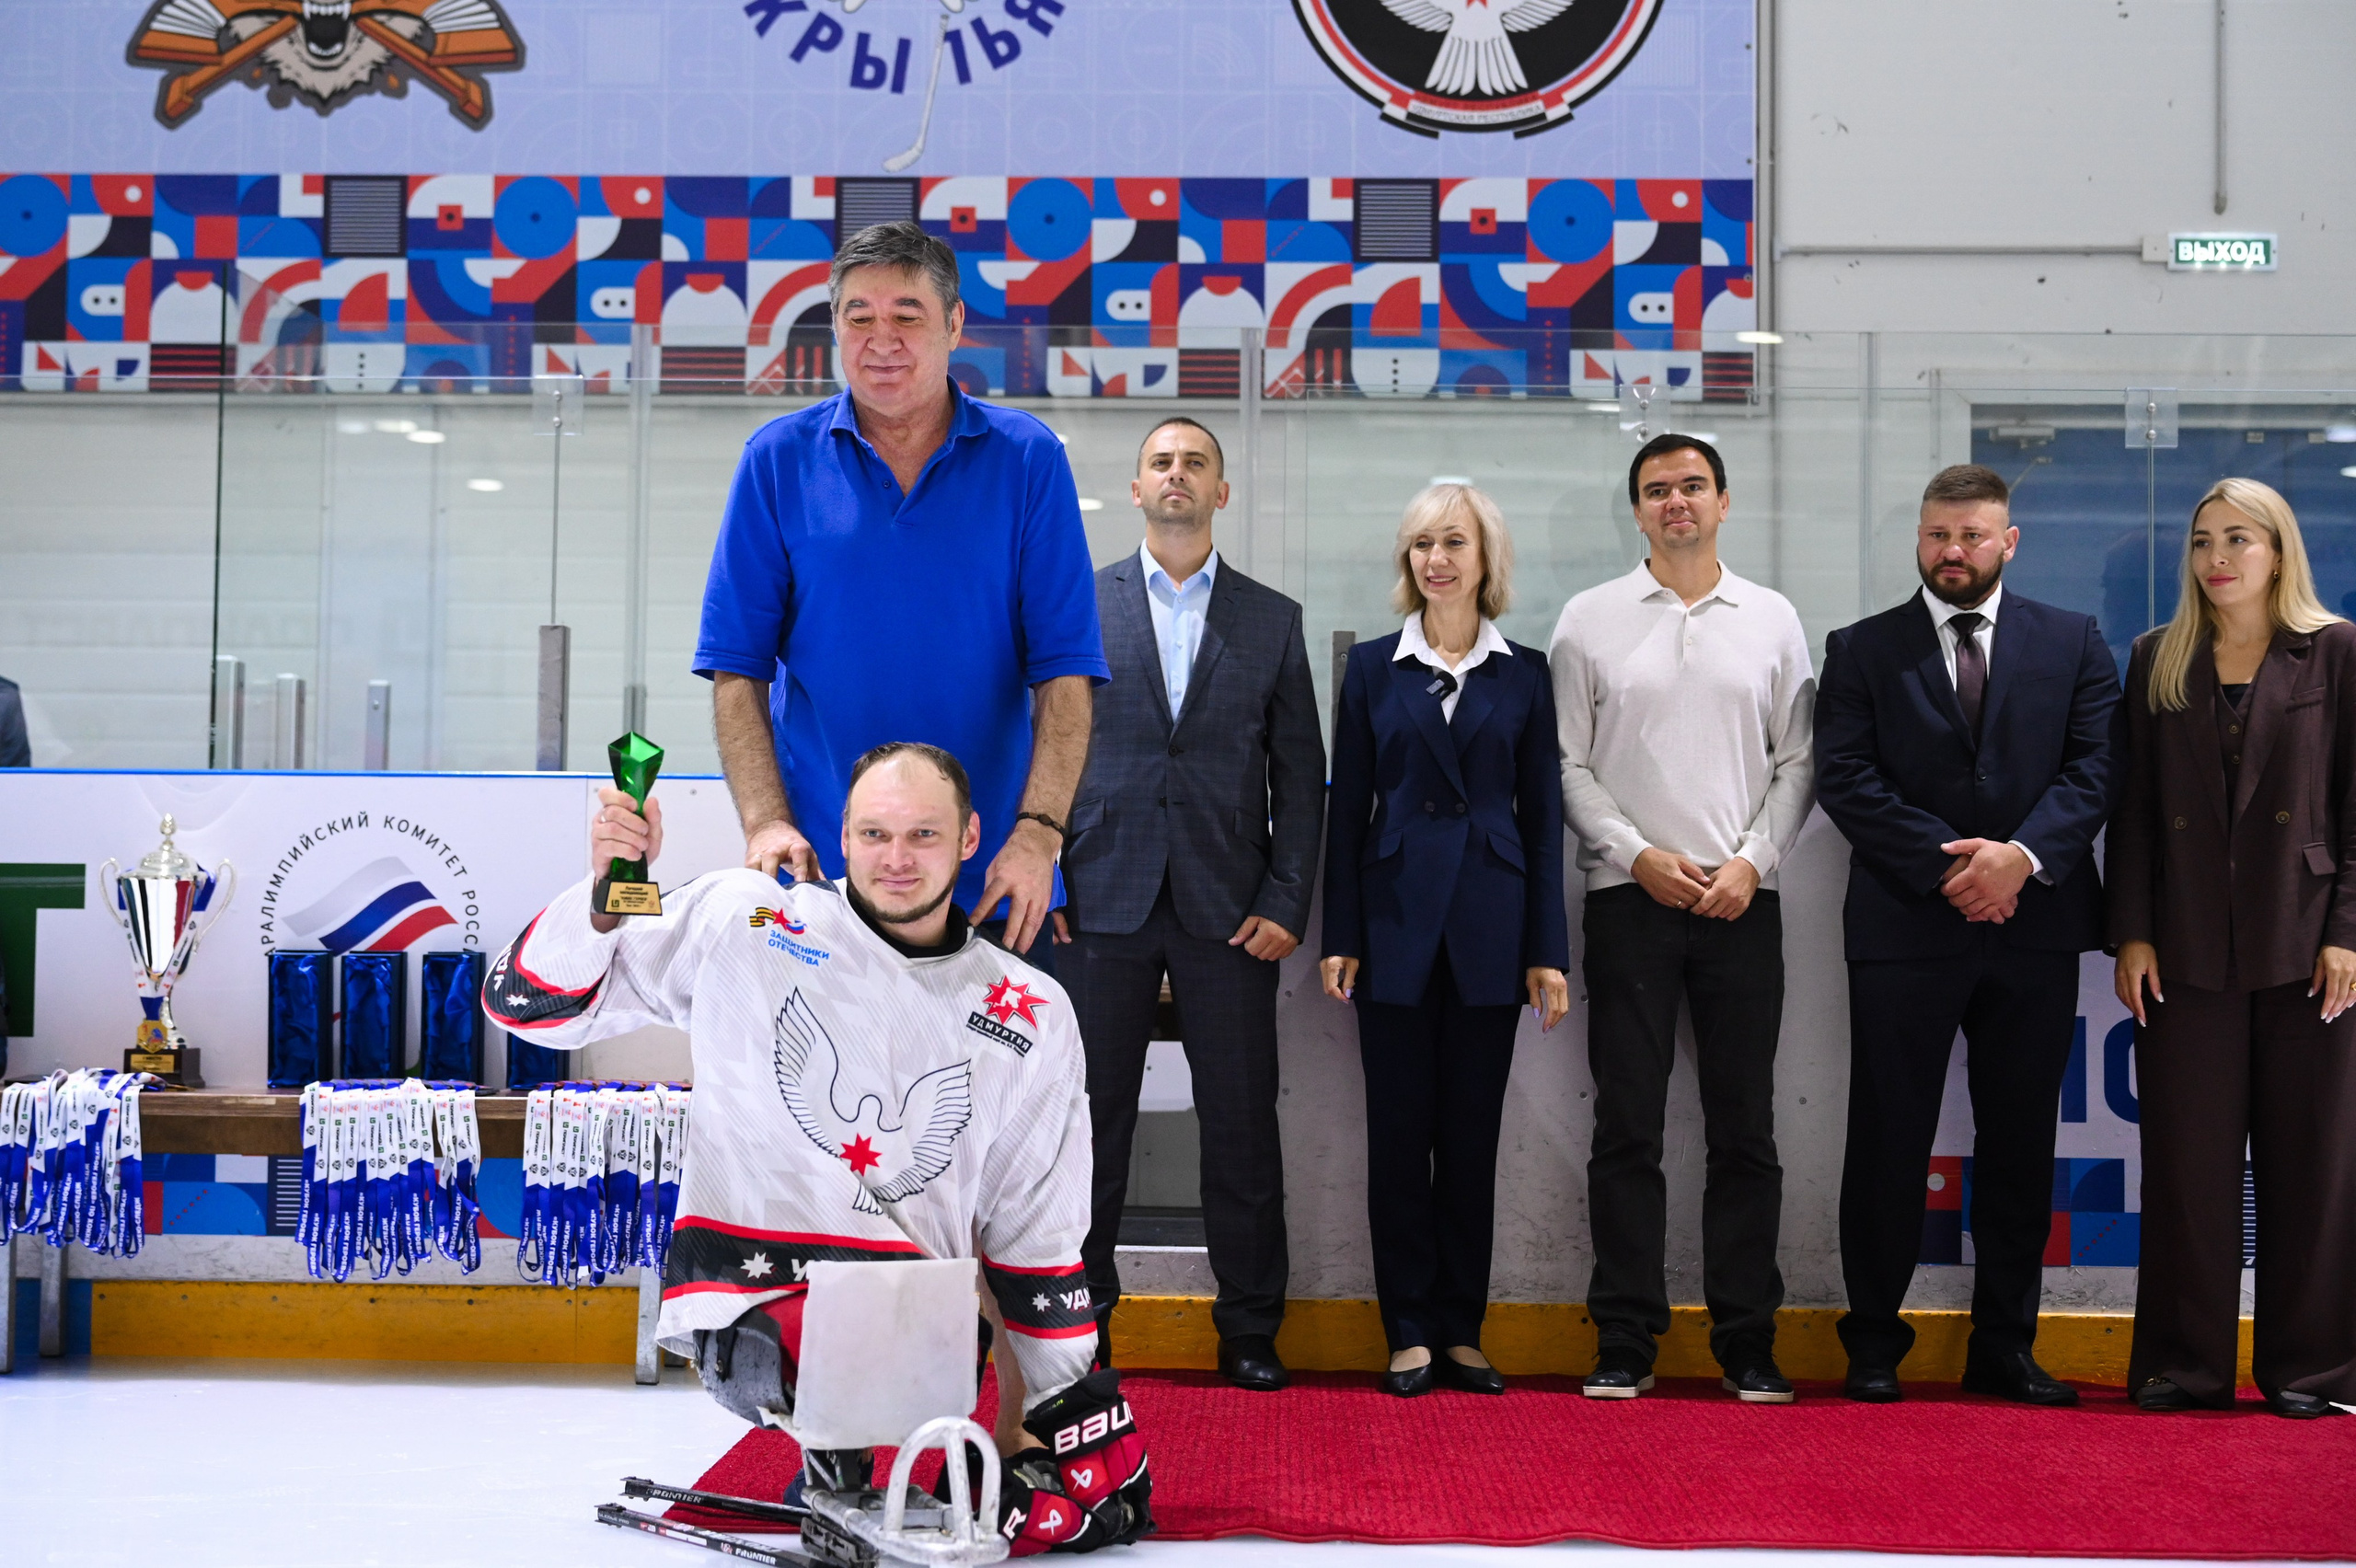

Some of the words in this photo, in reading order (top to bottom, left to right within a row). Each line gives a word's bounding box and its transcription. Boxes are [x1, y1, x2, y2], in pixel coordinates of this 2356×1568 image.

[2177, 240, 2266, 265] ВЫХОД
[384, 815, 468, 878] КОМИТЕТ
[461, 890, 479, 952] РОСС
[768, 939, 820, 967] ОТЕЧЕСТВА
[769, 929, 830, 961] ЗАЩИТНИКИ
[972, 1014, 1031, 1051] УДМУРТИЯ
[88, 1205, 96, 1216] ПО
[298, 1209, 309, 1242] ГЕРОЕВ»
[311, 1213, 320, 1242] «КУБОК
[327, 1213, 336, 1243] «КУБОК
[449, 1222, 458, 1254] ГЕРОЕВ»
[550, 1216, 559, 1246] «КУБОК
[561, 1220, 571, 1251] «КУБОК
[657, 1215, 666, 1244] «КУБОК
[340, 1242, 350, 1275] ГЕРОЕВ»
[547, 1246, 556, 1279] ГЕРОЕВ»
[735, 1548, 776, 1565] FRONTIER
